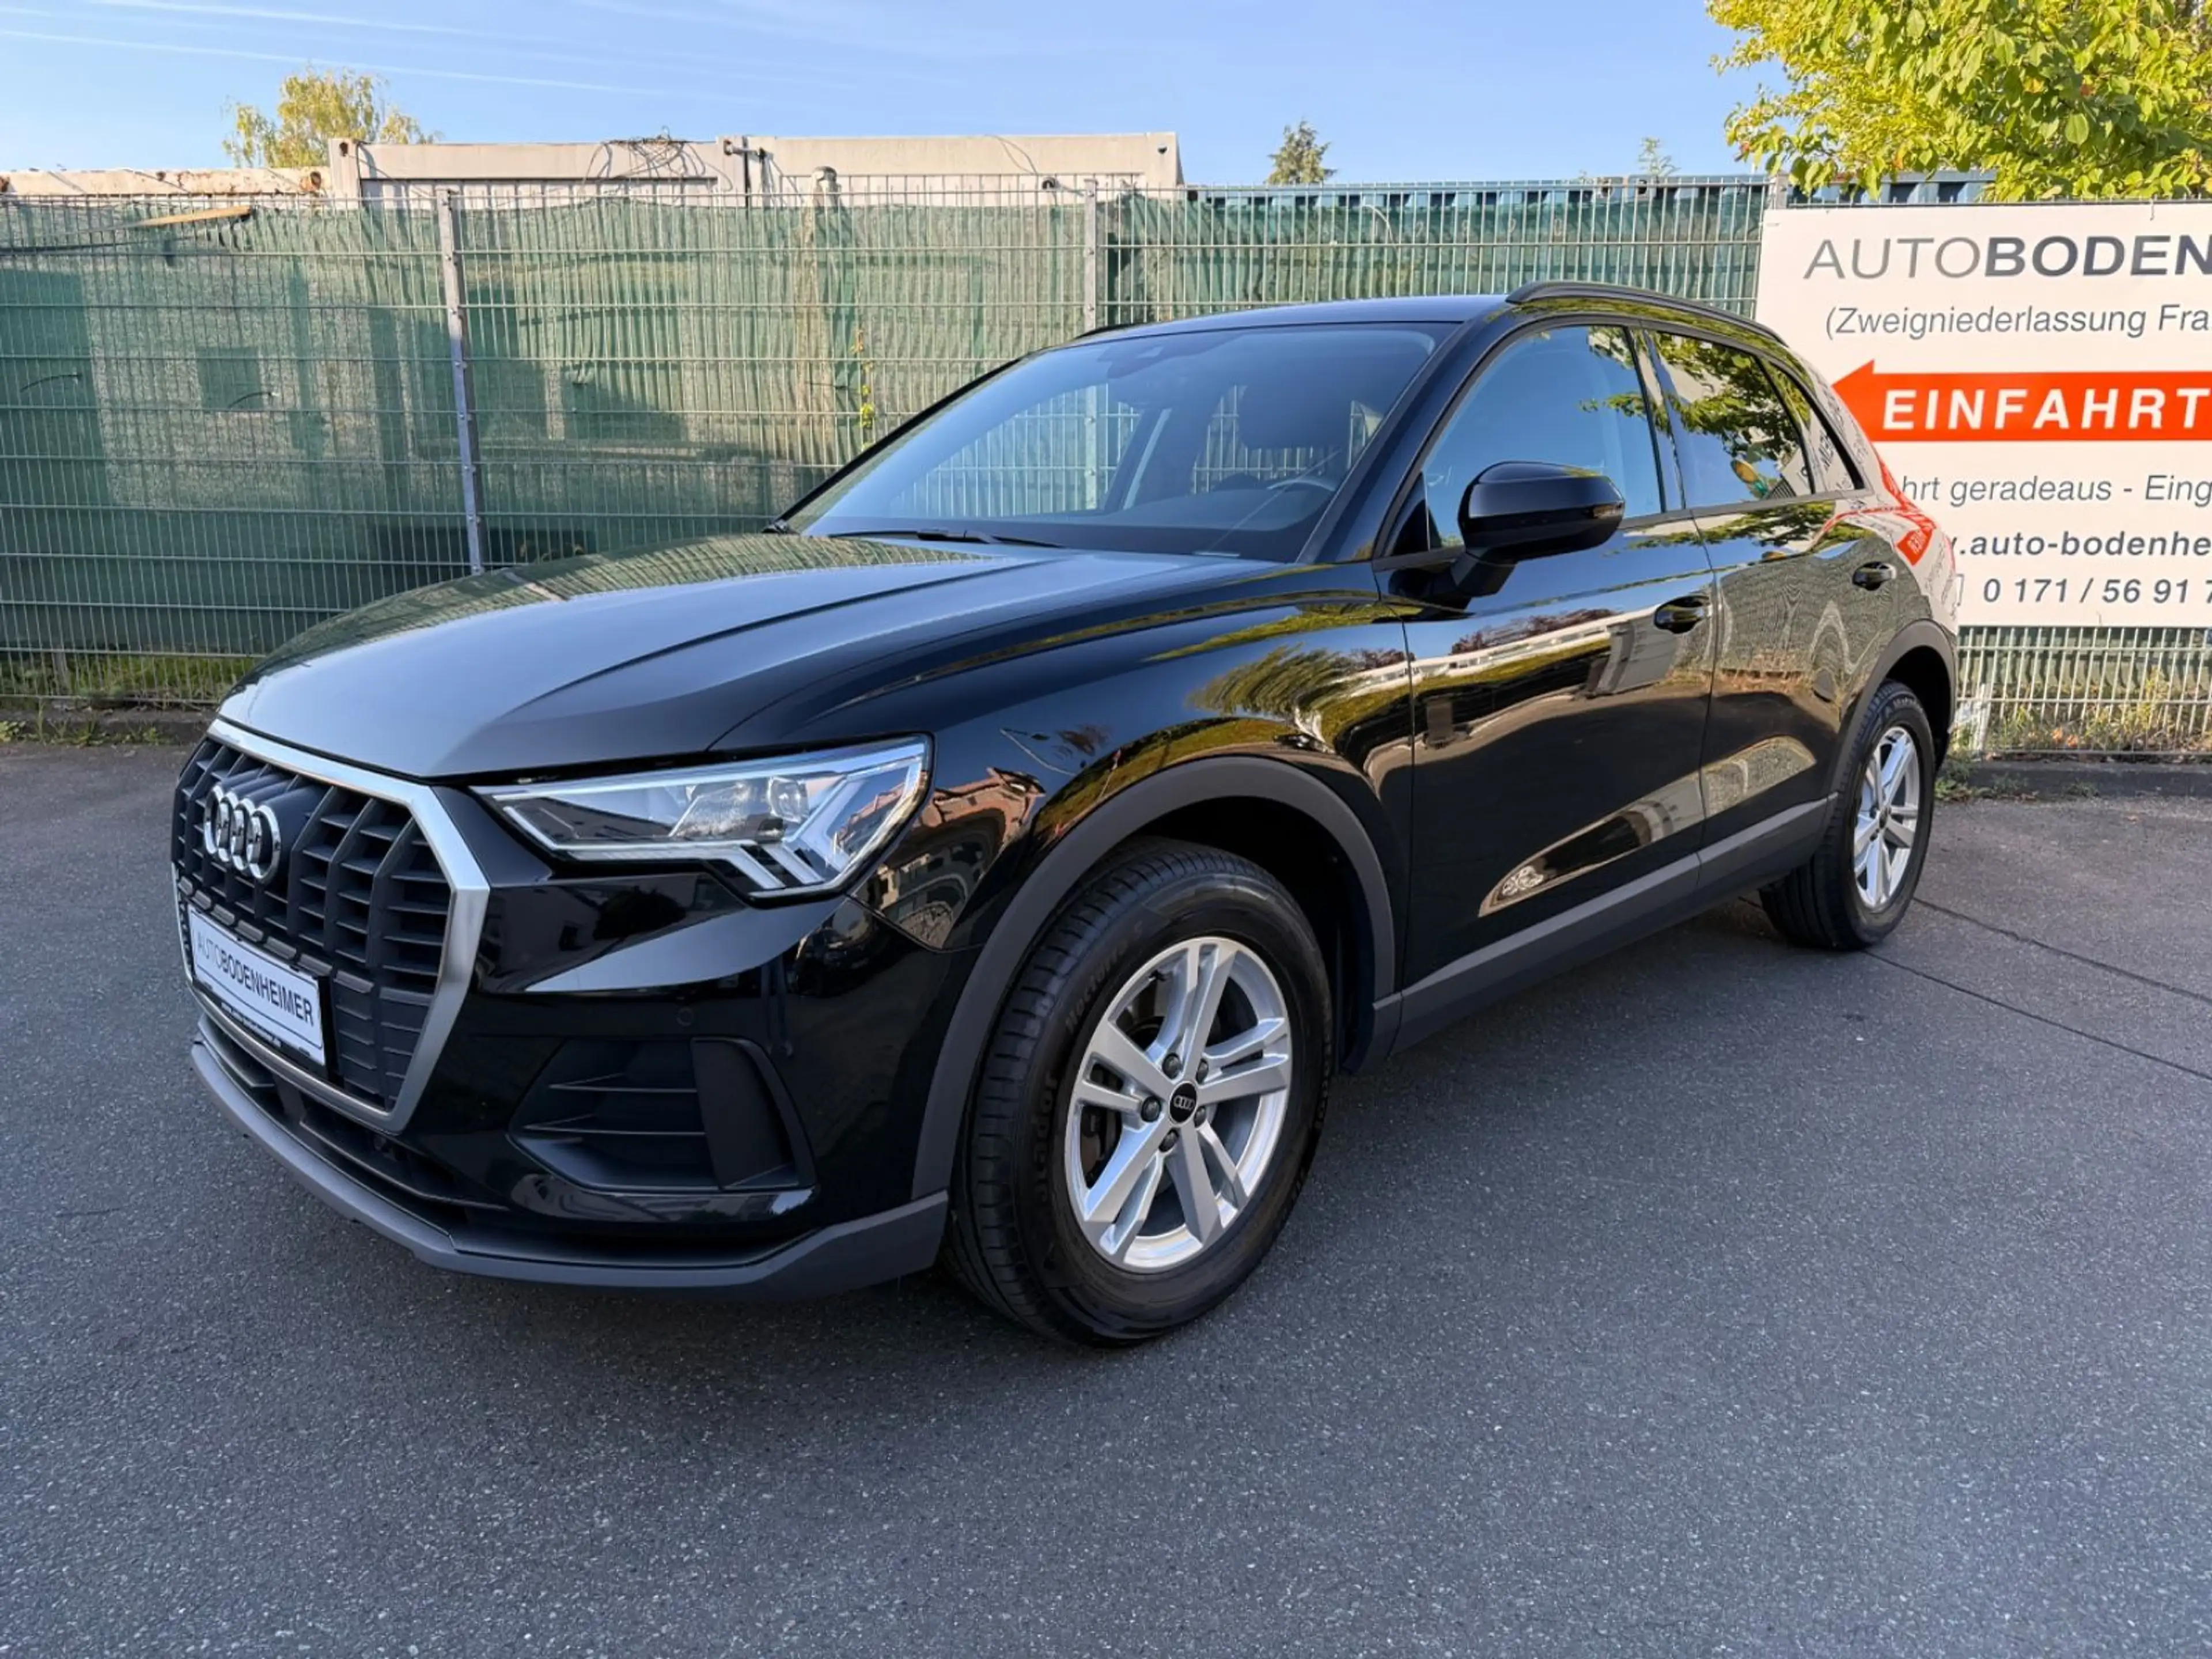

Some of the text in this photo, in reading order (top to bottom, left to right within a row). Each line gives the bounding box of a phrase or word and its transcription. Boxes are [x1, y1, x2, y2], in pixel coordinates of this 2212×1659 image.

[1827, 306, 2146, 340] (Zweigniederlassung
[1885, 389, 2211, 429] EINFAHRT
[1951, 476, 2111, 507] geradeaus
[2016, 578, 2067, 602] 171
[2103, 579, 2141, 603] 56
[2154, 579, 2188, 603] 91
[196, 929, 315, 1026] AUTOBODENHEIMER
